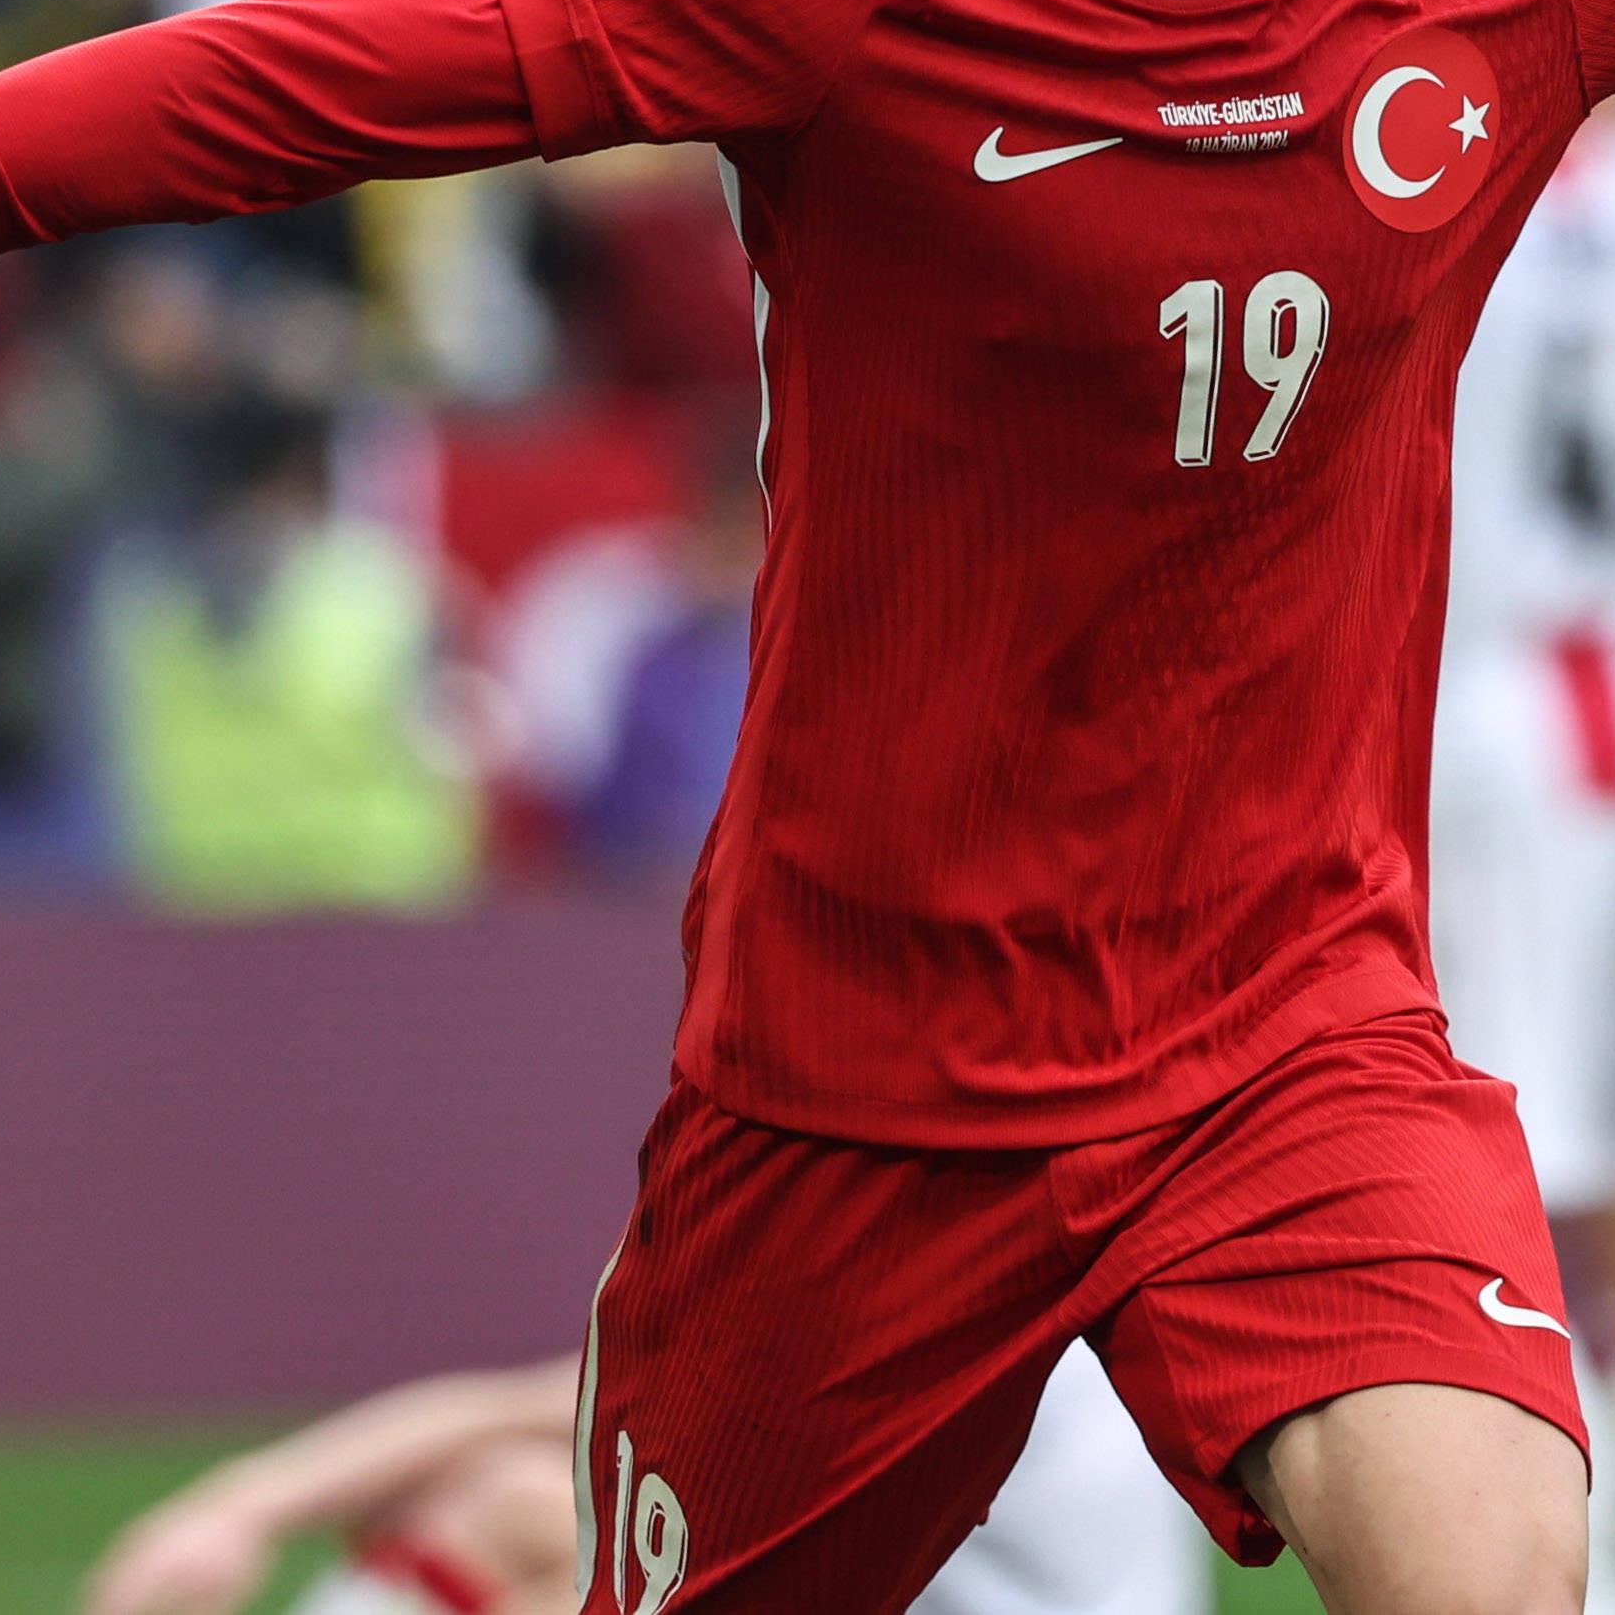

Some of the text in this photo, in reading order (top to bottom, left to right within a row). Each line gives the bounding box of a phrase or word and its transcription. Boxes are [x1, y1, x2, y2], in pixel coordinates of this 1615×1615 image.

[1157, 91, 1305, 127] TÜRKİYE-GÜRCİSTAN
[1202, 130, 1258, 154] HAZİRAN
[1259, 129, 1289, 152] 2024
[1158, 269, 1331, 468] 19
[612, 1428, 690, 1615] 19
